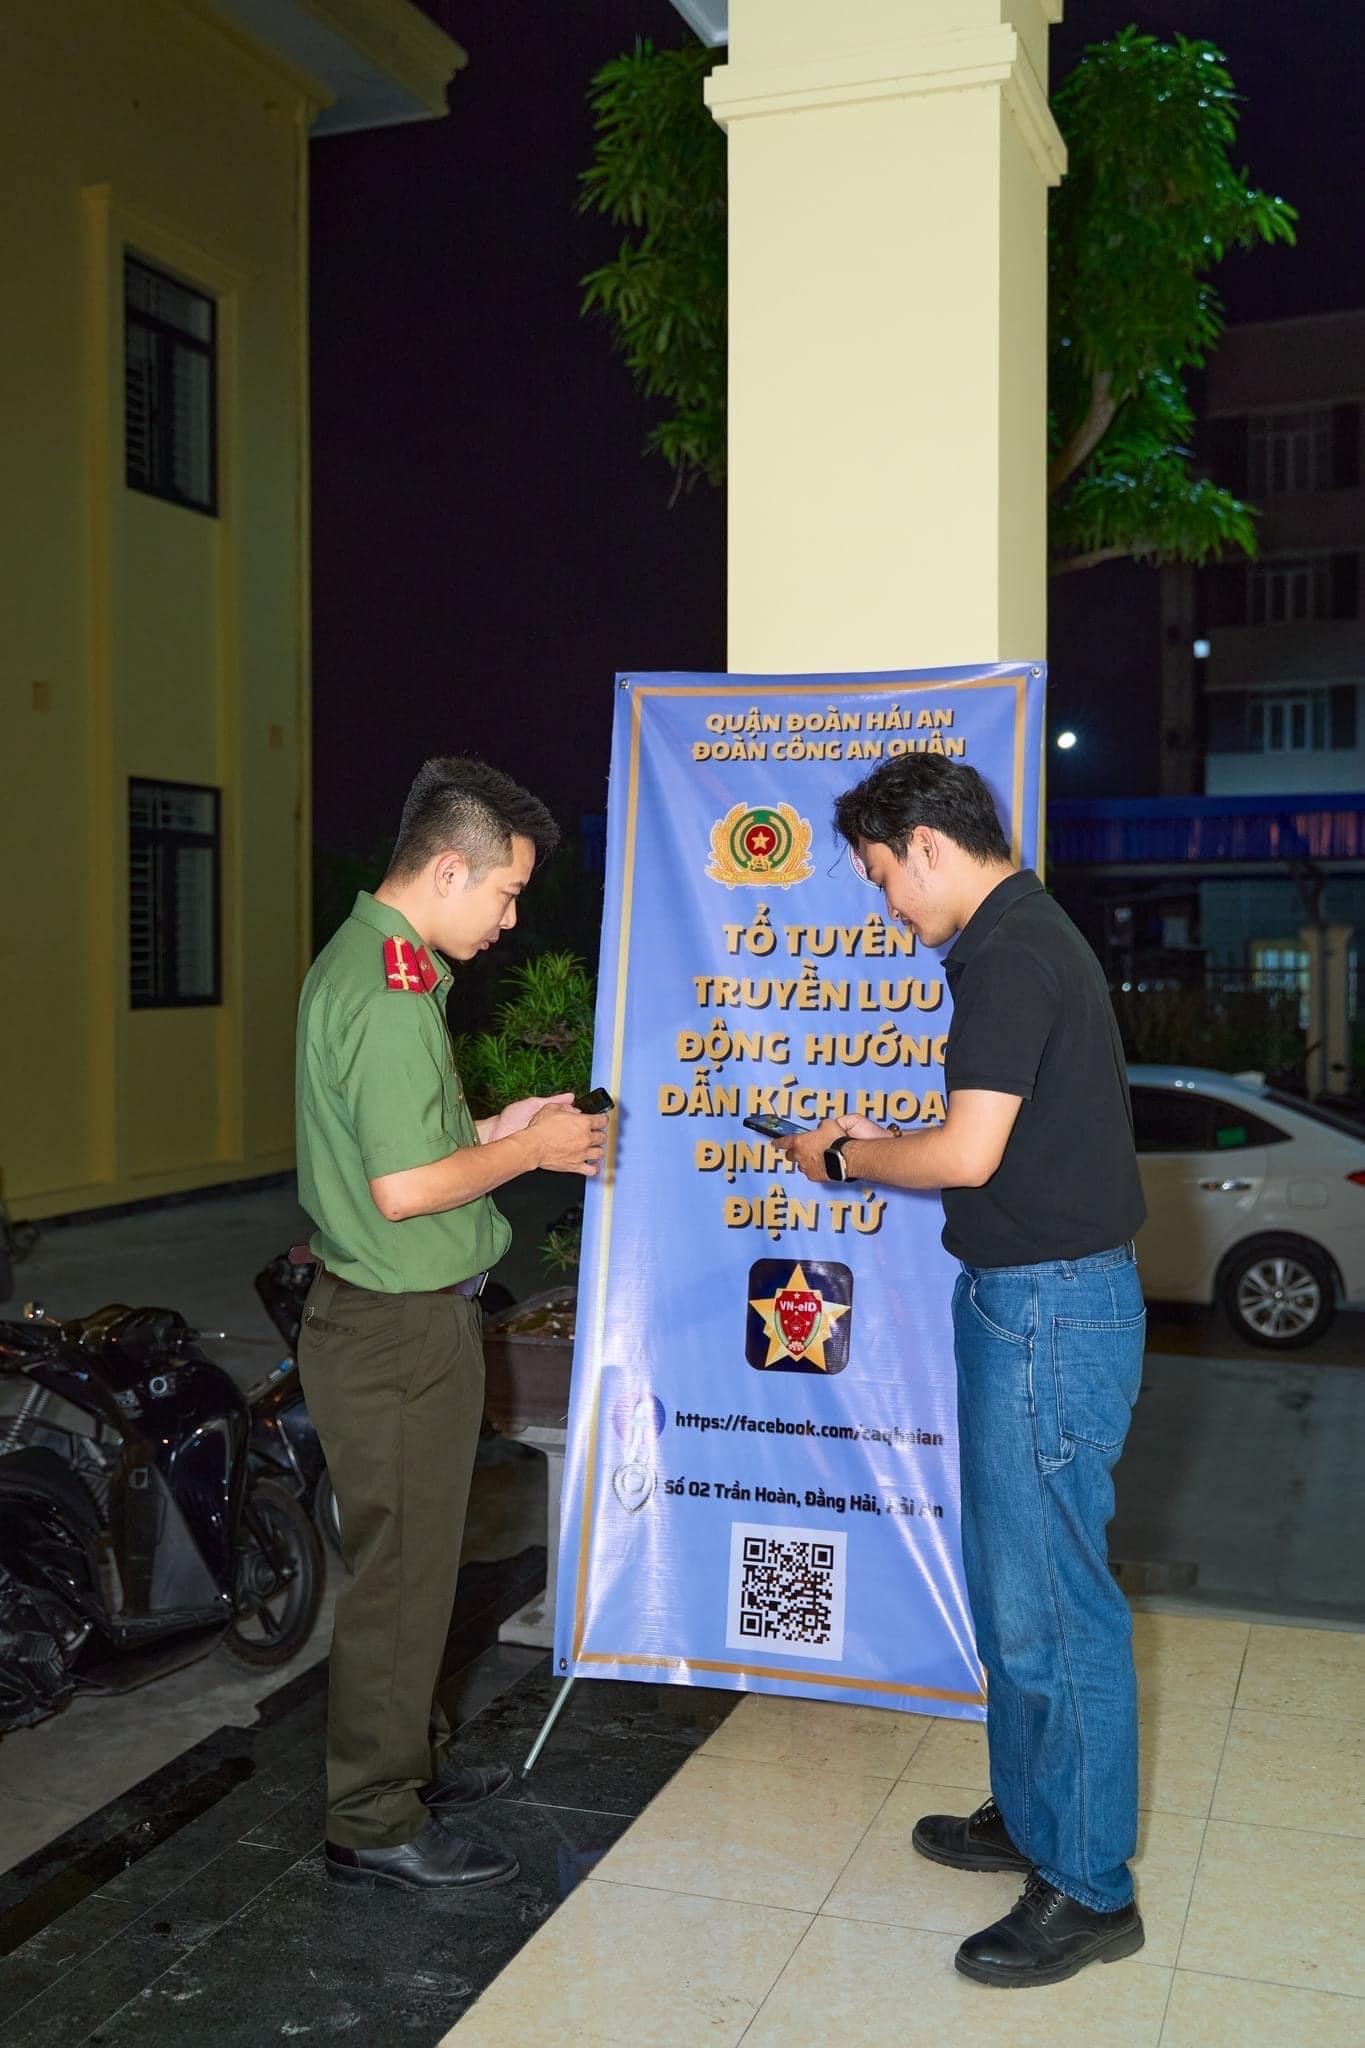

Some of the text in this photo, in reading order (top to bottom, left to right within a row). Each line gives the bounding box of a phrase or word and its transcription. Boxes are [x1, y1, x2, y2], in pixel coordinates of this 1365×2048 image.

[705, 703, 954, 739] QUẬN ĐOÀN HẢI AN
[692, 736, 767, 762] ĐOÀN
[771, 735, 842, 761] CÔNG
[846, 740, 882, 760] AN
[722, 903, 917, 957] TỔ TUYÊN
[692, 960, 945, 1012] TRUYỀN LƯU
[675, 1017, 791, 1073] ĐỘNG
[658, 1066, 741, 1118] DẪN
[746, 1075, 851, 1120] KÍCH
[722, 1183, 887, 1242] ĐIỆN TỬ
[664, 1476, 685, 1495] Số
[688, 1482, 711, 1498] 02
[714, 1480, 751, 1501] Trần
[754, 1487, 801, 1507] Hoàn,
[850, 1493, 881, 1516] Hải,
